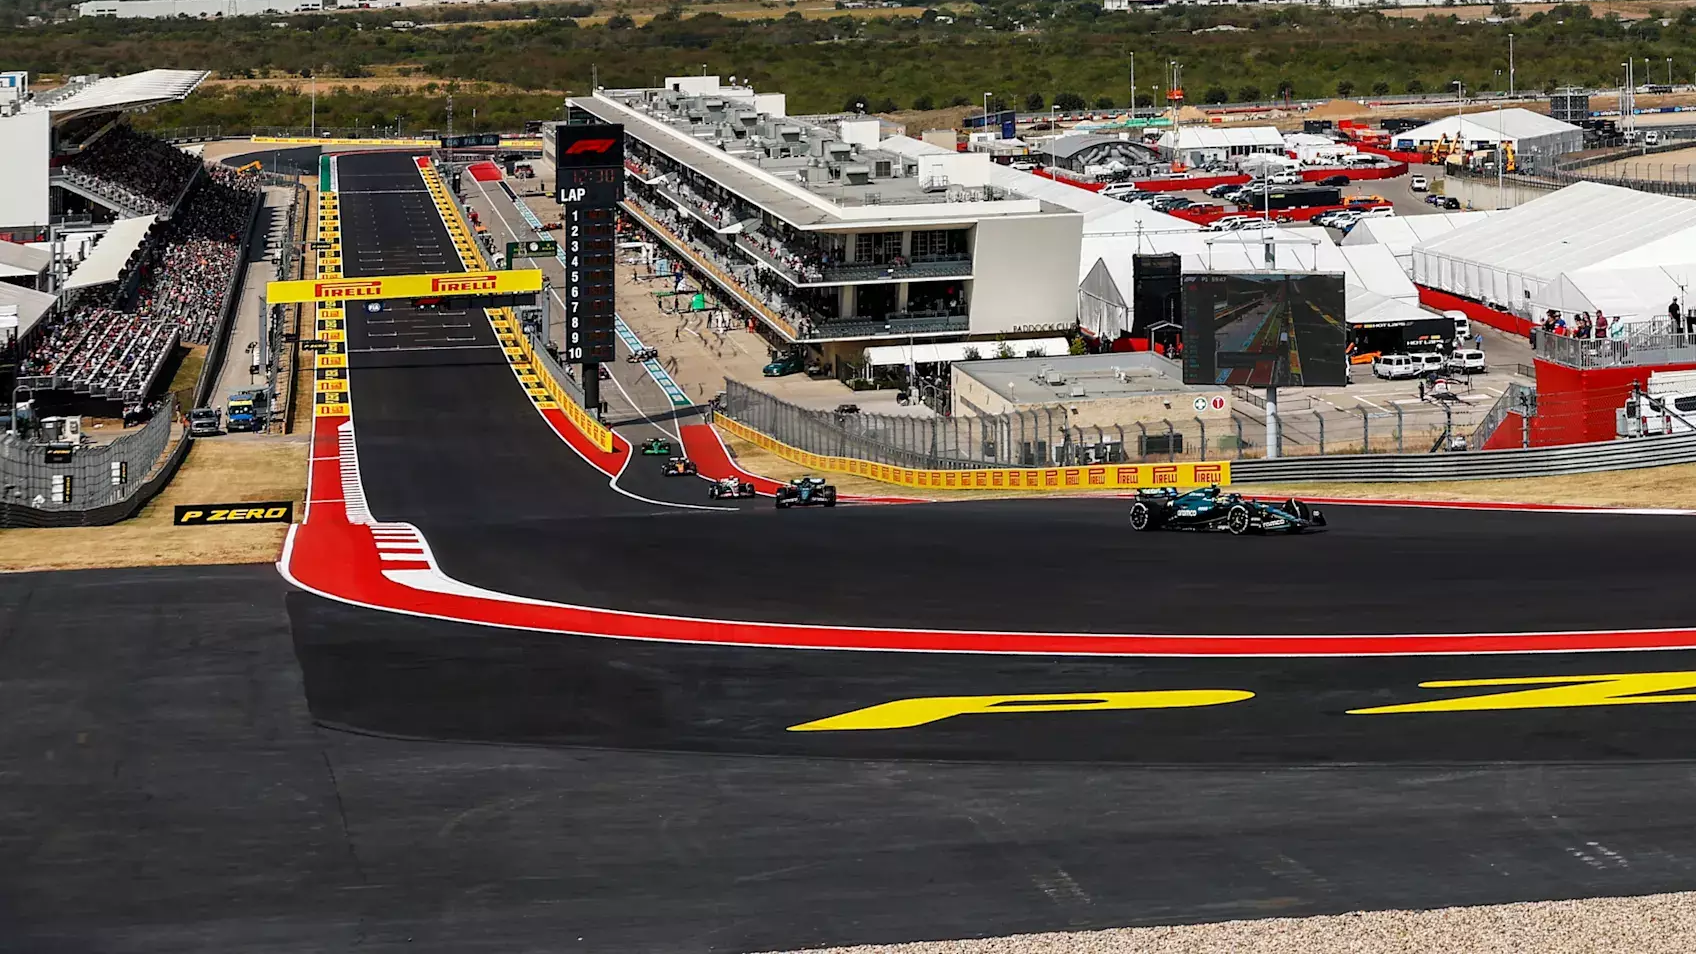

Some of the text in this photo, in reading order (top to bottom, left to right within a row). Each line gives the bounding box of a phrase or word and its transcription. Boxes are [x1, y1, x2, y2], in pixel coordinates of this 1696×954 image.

[561, 188, 585, 201] LAP
[571, 210, 578, 221] 1
[571, 226, 578, 236] 2
[571, 241, 578, 252] 3
[571, 256, 578, 267] 4
[571, 271, 578, 282] 5
[315, 275, 497, 297] PIRELLI PIRELLI
[571, 287, 578, 297] 6
[571, 302, 578, 312] 7
[571, 317, 578, 328] 8
[1013, 324, 1054, 332] PADDOCK
[571, 332, 578, 343] 9
[568, 348, 582, 358] 10
[1066, 470, 1079, 485] PIRELLI
[1088, 468, 1105, 484] PIRELLI
[1118, 467, 1138, 484] PIRELLI
[1153, 466, 1177, 484] PIRELLI
[1194, 465, 1221, 482] PIRELLI
[181, 507, 287, 522] P ZERO
[788, 690, 1255, 731] P
